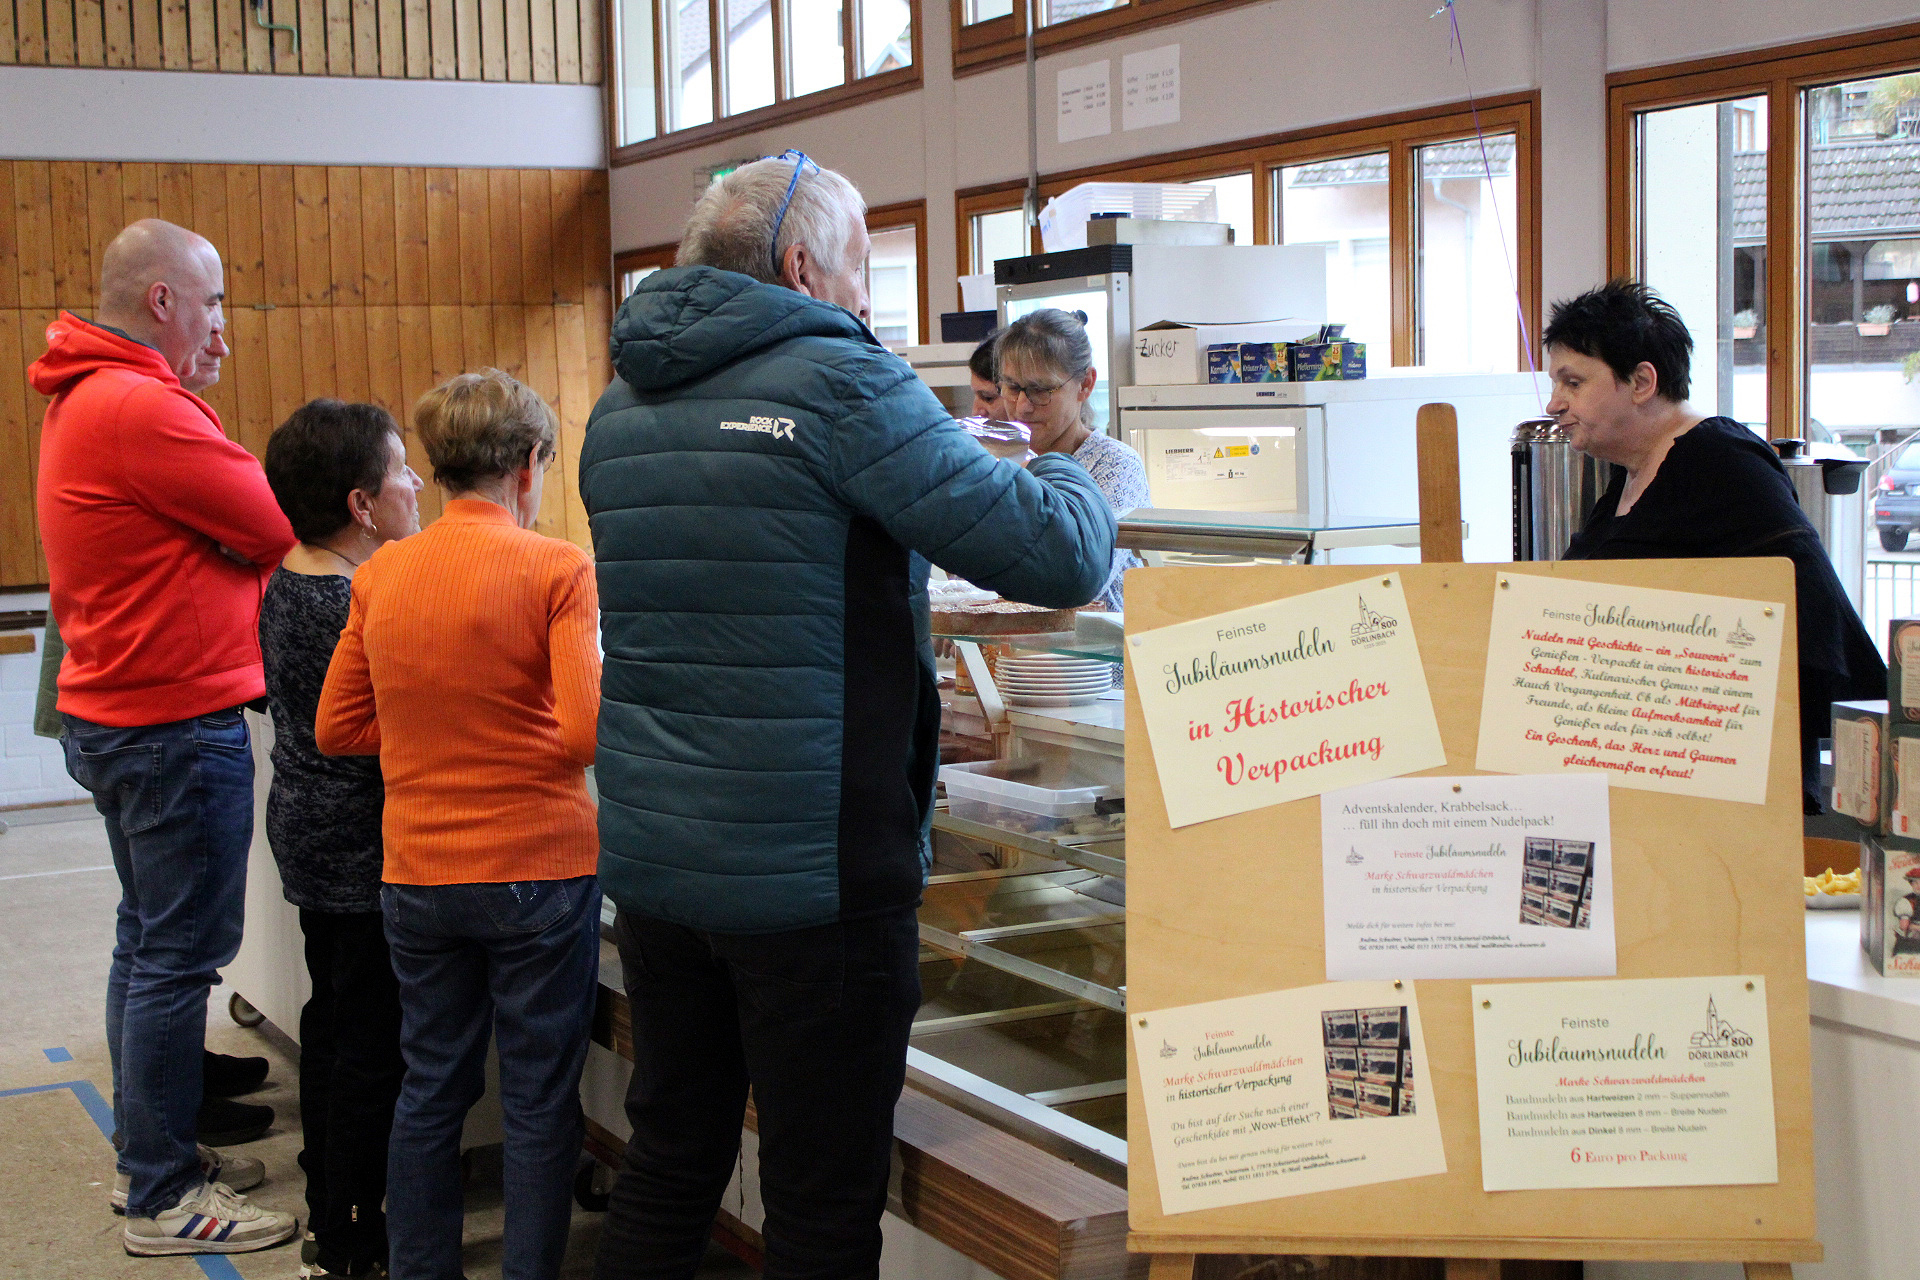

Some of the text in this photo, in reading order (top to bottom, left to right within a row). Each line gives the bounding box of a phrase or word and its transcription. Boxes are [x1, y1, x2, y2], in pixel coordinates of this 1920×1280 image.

[1136, 337, 1180, 359] Zucker
[1333, 347, 1340, 355] 25
[720, 421, 773, 434] EXPERIENCE
[750, 416, 774, 425] ROCK
[1381, 619, 1398, 630] 800
[1542, 604, 1718, 637] Feinste Jubiläumsnudeln
[1216, 621, 1267, 641] Feinste
[1351, 629, 1396, 647] DÖRLINBACH
[1521, 629, 1564, 643] Nudeln
[1566, 636, 1585, 645] mit
[1587, 636, 1643, 652] Geschichte
[1655, 646, 1672, 656] ein
[1739, 658, 1763, 667] zum
[1163, 626, 1335, 694] Jubiläumsnudeln
[1530, 646, 1580, 662] Genießen
[1590, 653, 1642, 668] Verpackt
[1643, 660, 1655, 670] in
[1656, 663, 1683, 673] einer
[1685, 664, 1749, 681] historischen
[1523, 661, 1754, 698] Schachtel, Kulinarischer Genuss mit einem
[1512, 676, 1761, 717] Hauch Vergangenheit. Ob als Mitbringsel für
[1188, 678, 1390, 742] in Historischer
[1525, 694, 1744, 731] Freunde, als kleine Aufmerksamkeit für
[1553, 714, 1713, 742] Genießer oder für sich selbst!
[1524, 729, 1737, 765] Ein Geschenk, das Herz und Gaumen
[1216, 736, 1385, 786] Verpackung
[1563, 754, 1695, 778] gleichermaßen erfreut!
[1342, 802, 1438, 814] Adventskalender,
[1359, 818, 1378, 829] füll
[1381, 818, 1400, 829] ihn
[1401, 817, 1429, 828] doch
[1432, 819, 1451, 828] mit
[1453, 819, 1488, 827] einem
[1490, 815, 1555, 828] Nudelpack!
[1393, 842, 1507, 859] Feinste Jubiläumsnudeln
[1367, 869, 1495, 881] Marke Schwarzwaldmädchen
[1383, 883, 1433, 893] historischer
[1435, 882, 1489, 895] Verpackung
[1561, 1017, 1610, 1028] Feinste
[1204, 1030, 1235, 1040] Feinste
[1731, 1036, 1753, 1047] 800
[1193, 1034, 1273, 1060] Jubiläumsnudeln
[1507, 1033, 1666, 1067] Jubiläumsnudeln
[1688, 1050, 1748, 1060] DÖRLINBACH
[1165, 1056, 1304, 1085] Marke Schwarzwaldmädchen
[1558, 1073, 1706, 1086] Marke Schwarzwaldmädchen
[1165, 1074, 1292, 1102] in historischer Verpackung
[1505, 1093, 1567, 1104] Bandnudeln
[1586, 1094, 1635, 1102] Hartweizen
[1636, 1092, 1643, 1101] 2
[1670, 1090, 1731, 1100] Suppennudeln
[1170, 1102, 1310, 1131] Du bist auf der Suche nach einer
[1506, 1109, 1569, 1121] Bandnudeln
[1670, 1107, 1697, 1116] Breite
[1697, 1107, 1728, 1115] Nudeln
[1173, 1128, 1230, 1146] Geschenkidee
[1232, 1126, 1247, 1134] mit
[1507, 1126, 1570, 1137] Bandnudeln
[1588, 1126, 1617, 1134] Dinkel
[1650, 1125, 1676, 1133] Breite
[1677, 1124, 1708, 1132] Nudeln
[1570, 1147, 1688, 1164] 6 Euro pro Packung
